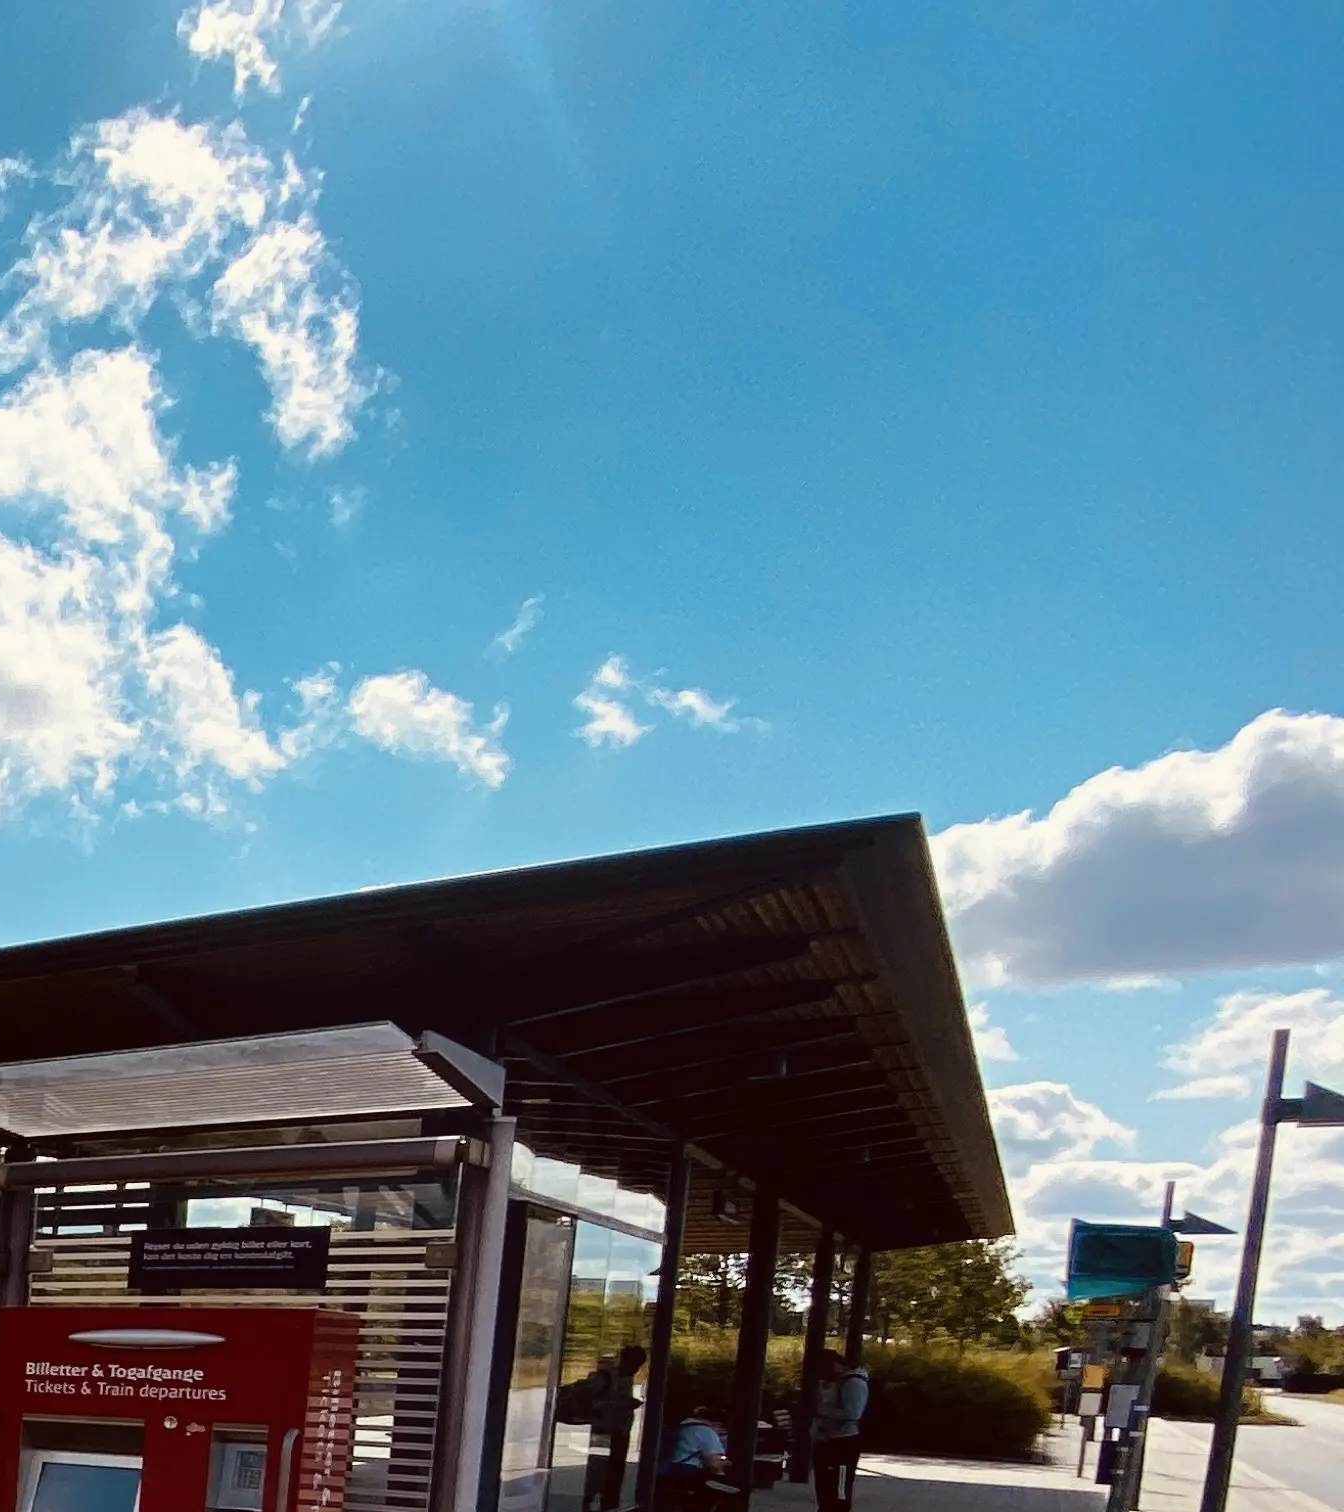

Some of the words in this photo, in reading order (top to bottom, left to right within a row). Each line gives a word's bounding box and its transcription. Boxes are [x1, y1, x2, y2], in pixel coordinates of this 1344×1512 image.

[26, 1361, 88, 1378] Billetter
[91, 1364, 104, 1378] &
[108, 1364, 204, 1382] Togafgange
[25, 1379, 76, 1395] Tickets
[80, 1381, 93, 1396] &
[97, 1381, 134, 1397] Train
[139, 1384, 227, 1402] departures
